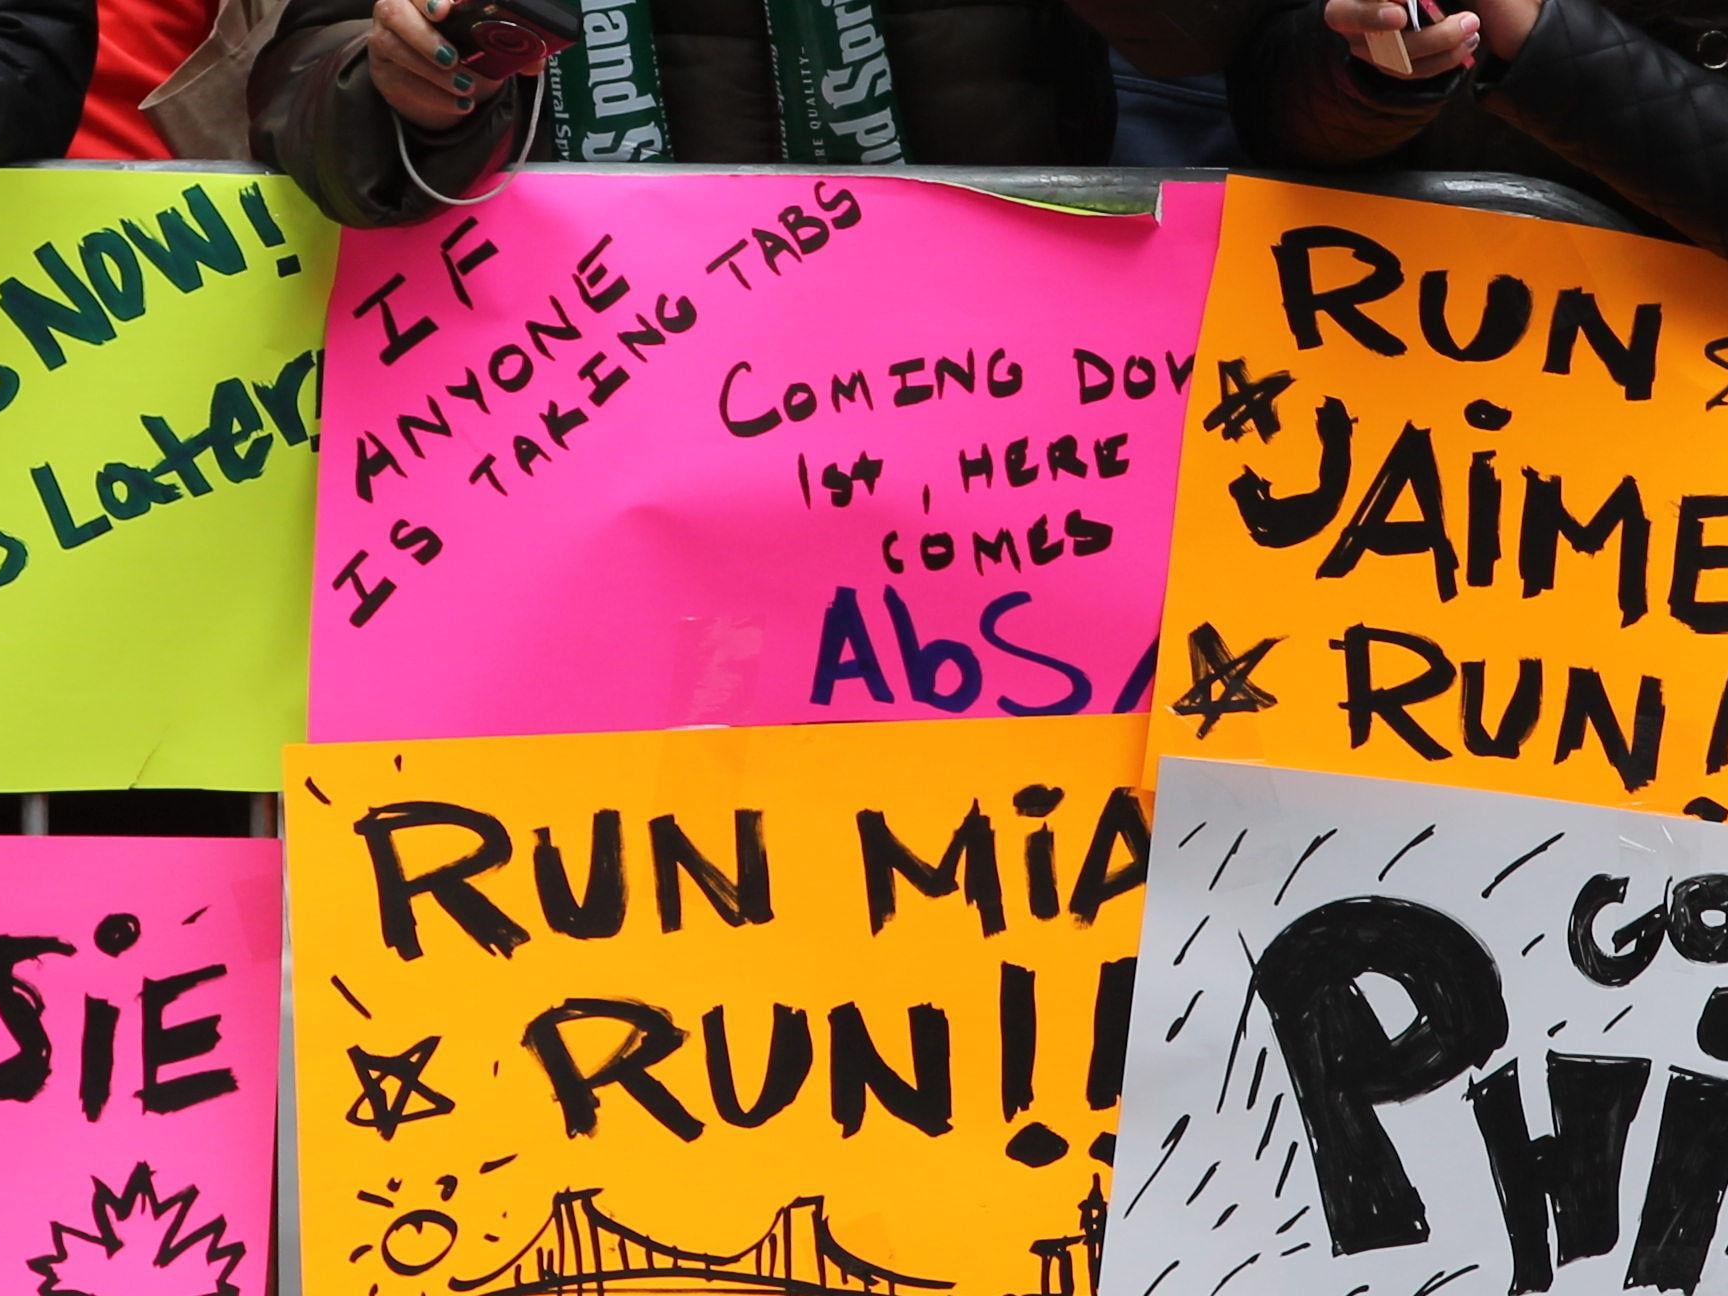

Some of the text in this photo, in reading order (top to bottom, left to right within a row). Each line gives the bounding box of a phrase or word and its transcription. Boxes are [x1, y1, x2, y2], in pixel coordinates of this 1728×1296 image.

[548, 50, 570, 119] atural
[352, 215, 500, 368] IF
[353, 233, 631, 503] ANYONE
[1270, 224, 1663, 402] RUN
[332, 180, 863, 629] IS TAKING TABS
[718, 347, 1024, 439] COMING
[962, 431, 1131, 494] HERE
[881, 508, 1115, 592] COMES
[353, 798, 775, 962] RUN
